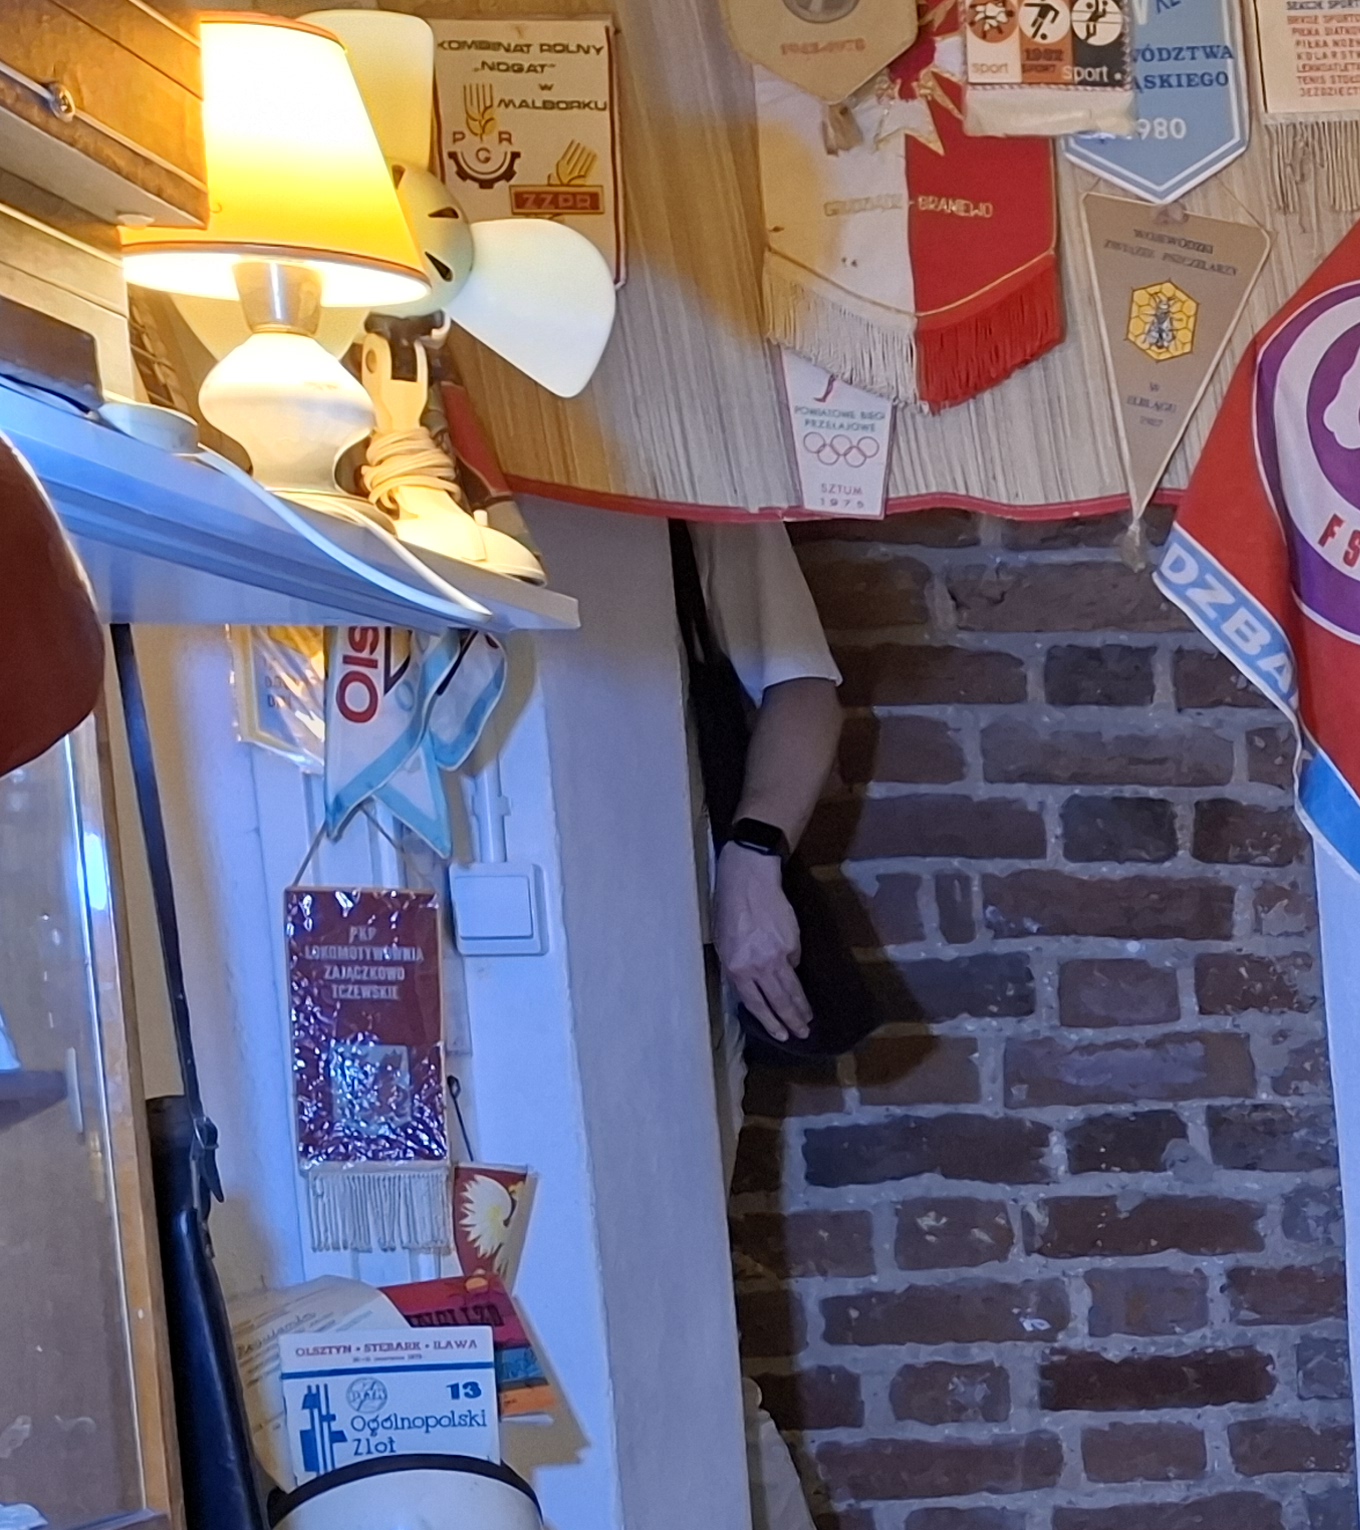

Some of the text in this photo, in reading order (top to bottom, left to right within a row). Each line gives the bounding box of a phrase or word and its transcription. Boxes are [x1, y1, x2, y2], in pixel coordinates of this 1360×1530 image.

[437, 39, 605, 56] KOMBINAT ROLNY
[1134, 46, 1235, 64] ÓDZTWA
[1061, 64, 1108, 82] sport
[1133, 71, 1229, 92] ĄSKIEGO
[497, 99, 608, 112] MALBORKU
[452, 131, 466, 144] P
[1138, 117, 1187, 140] 980
[820, 482, 863, 496] SZTUM
[348, 925, 378, 944] PKP
[331, 984, 400, 1000] TCZEWSKIE
[294, 1344, 353, 1358] OLSZTYN
[446, 1380, 483, 1401] 13
[350, 1409, 488, 1437] Ogólnopolski
[352, 1437, 397, 1457] Zlot
